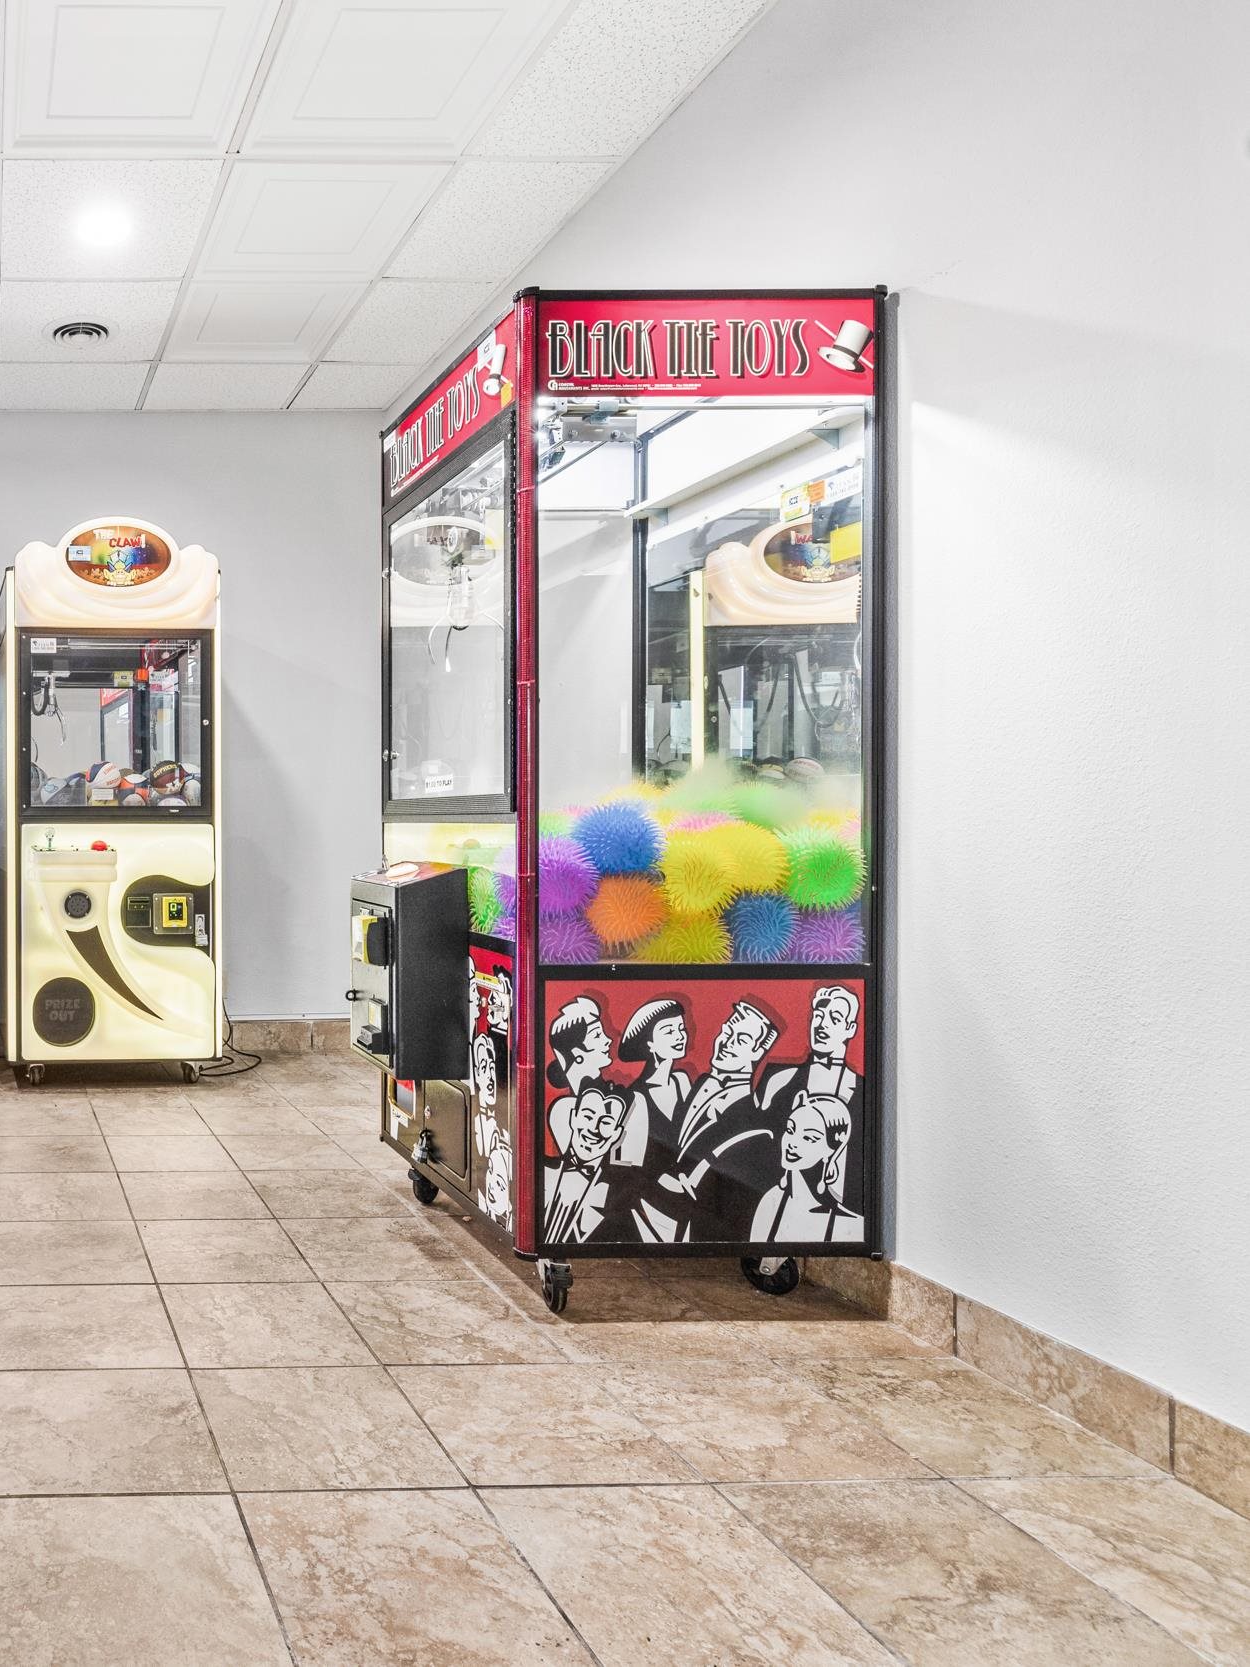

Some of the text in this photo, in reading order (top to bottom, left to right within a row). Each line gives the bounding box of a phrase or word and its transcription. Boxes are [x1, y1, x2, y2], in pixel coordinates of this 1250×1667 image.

[546, 318, 810, 378] BLACK TIE TOYS
[390, 416, 424, 488] BLACK
[425, 397, 445, 458] TIE
[446, 365, 481, 439] TOYS
[93, 529, 115, 541] THE
[109, 534, 146, 549] CLAW!
[45, 999, 81, 1010] PRIZE
[49, 1011, 76, 1021] OUT
